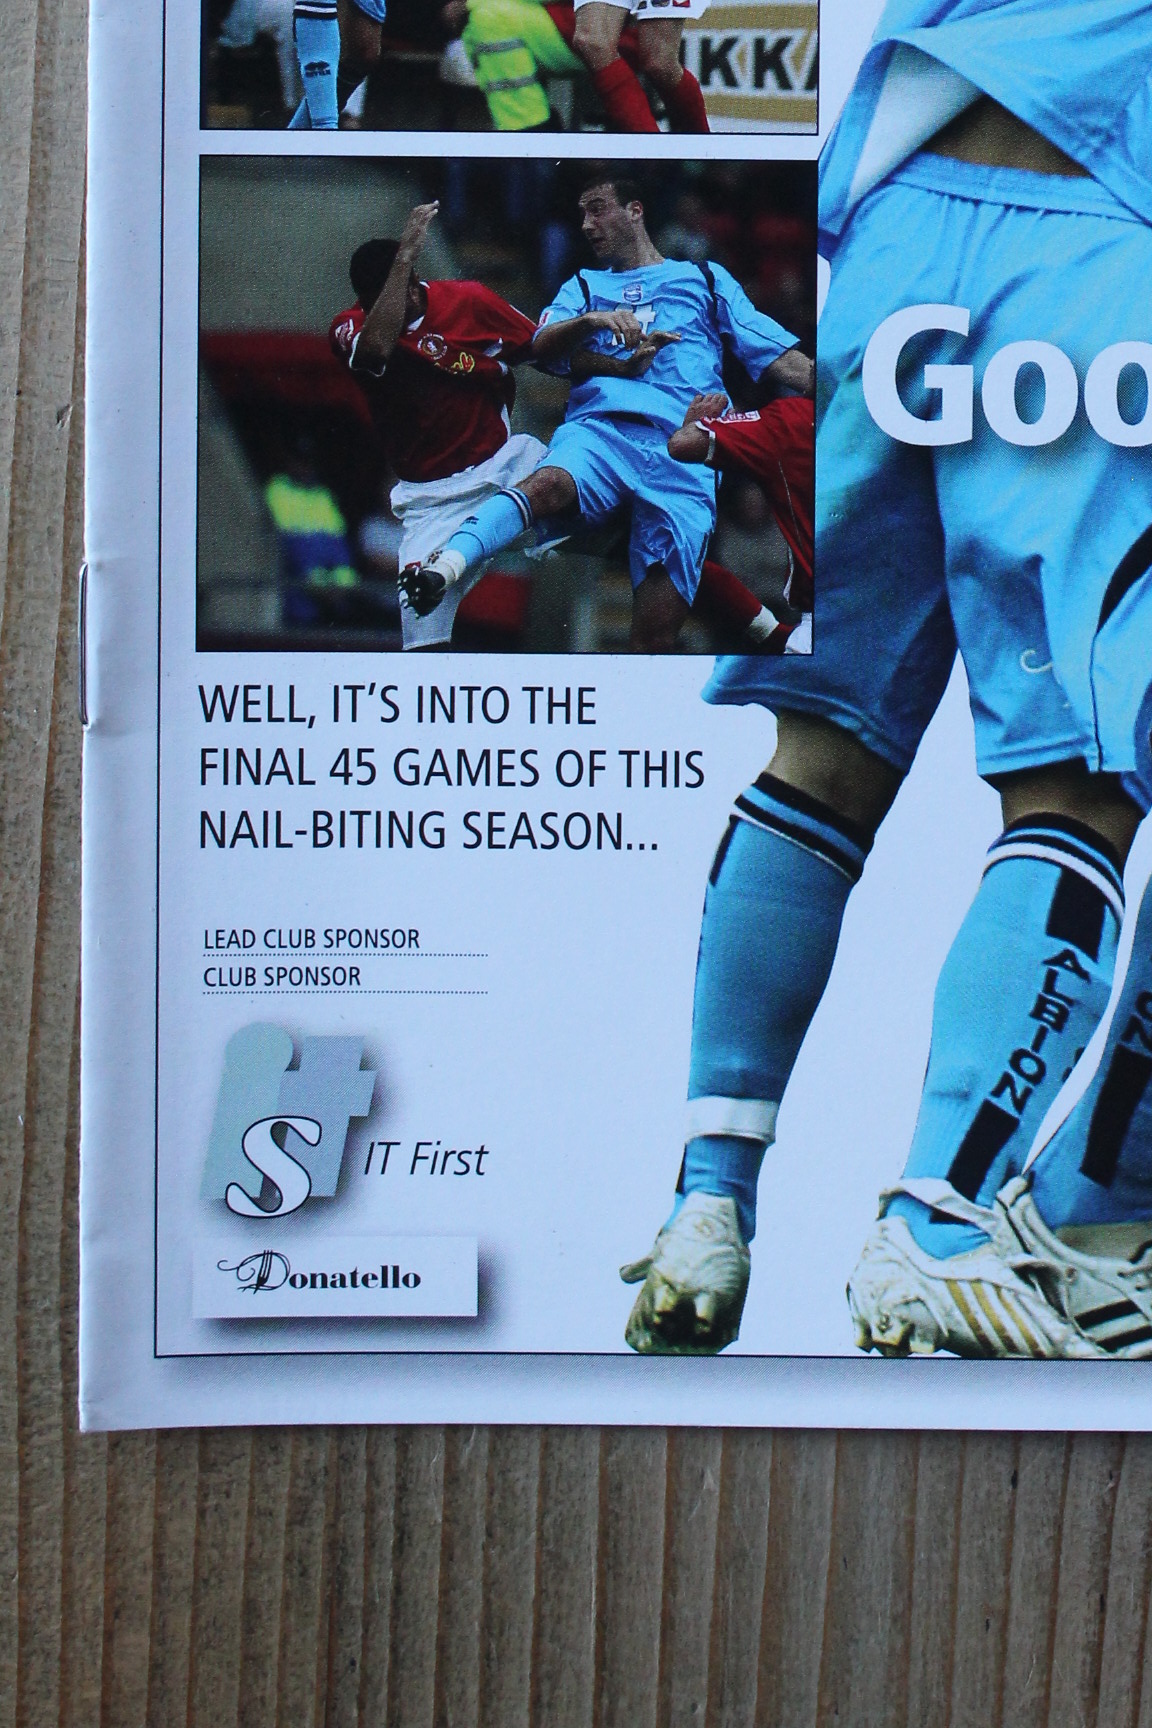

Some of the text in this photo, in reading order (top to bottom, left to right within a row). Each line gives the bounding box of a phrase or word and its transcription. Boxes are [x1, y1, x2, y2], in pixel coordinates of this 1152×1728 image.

[198, 683, 597, 729] WELL, IT’S INTO THE
[200, 747, 705, 789] FINAL 45 GAMES OF THIS
[200, 810, 658, 851] NAIL-BITING SEASON...
[204, 928, 420, 950] LEAD CLUB SPONSOR
[203, 966, 361, 988] CLUB SPONSOR
[991, 948, 1092, 1115] ALBION
[364, 1140, 490, 1176] IT First
[216, 1249, 422, 1295] Donatello
